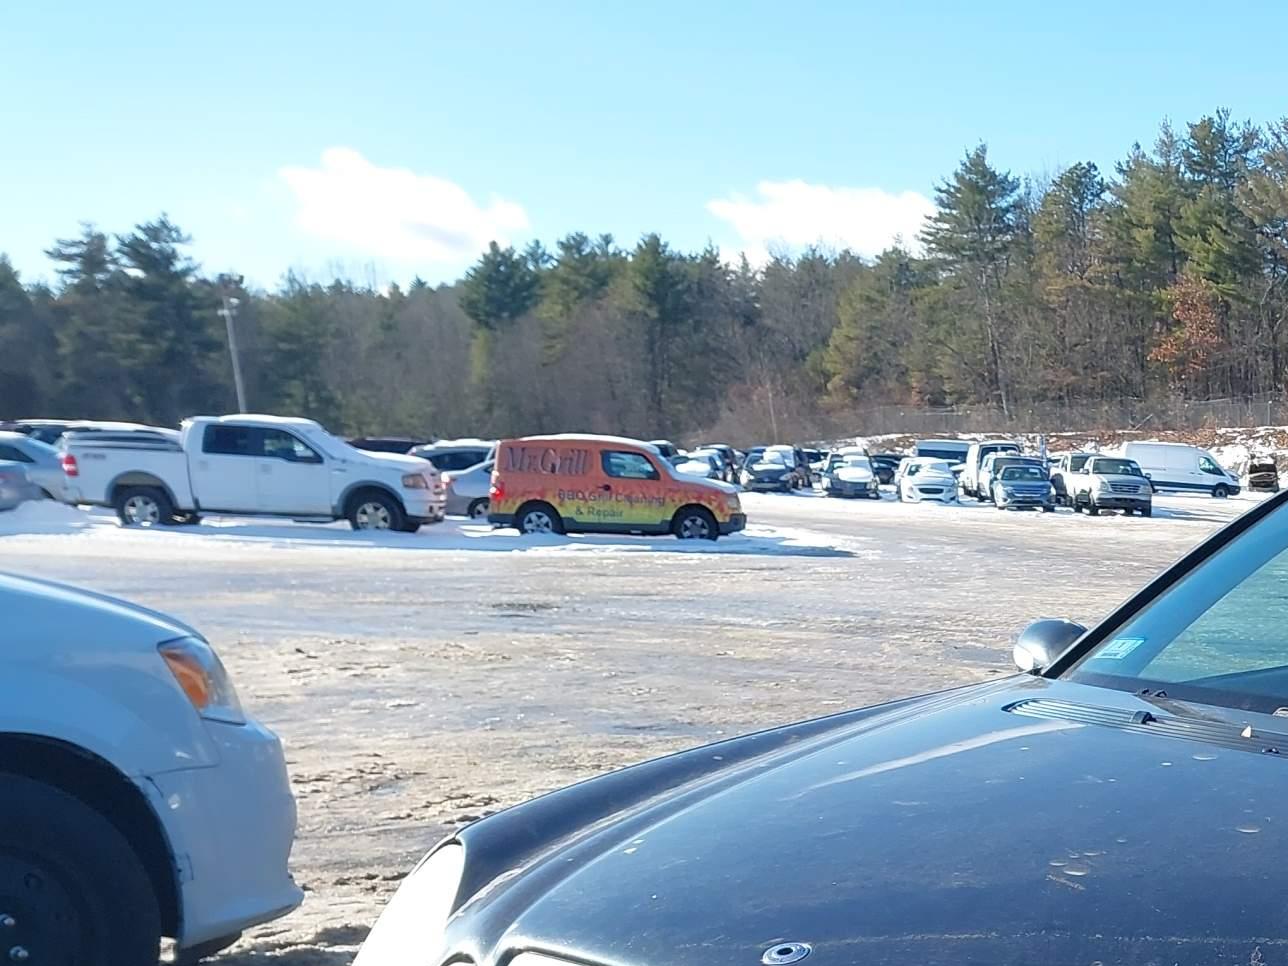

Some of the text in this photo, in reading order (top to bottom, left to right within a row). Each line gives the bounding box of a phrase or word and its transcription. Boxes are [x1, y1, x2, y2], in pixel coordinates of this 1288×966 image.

[540, 447, 588, 475] Grill
[576, 506, 623, 518] & Repair
